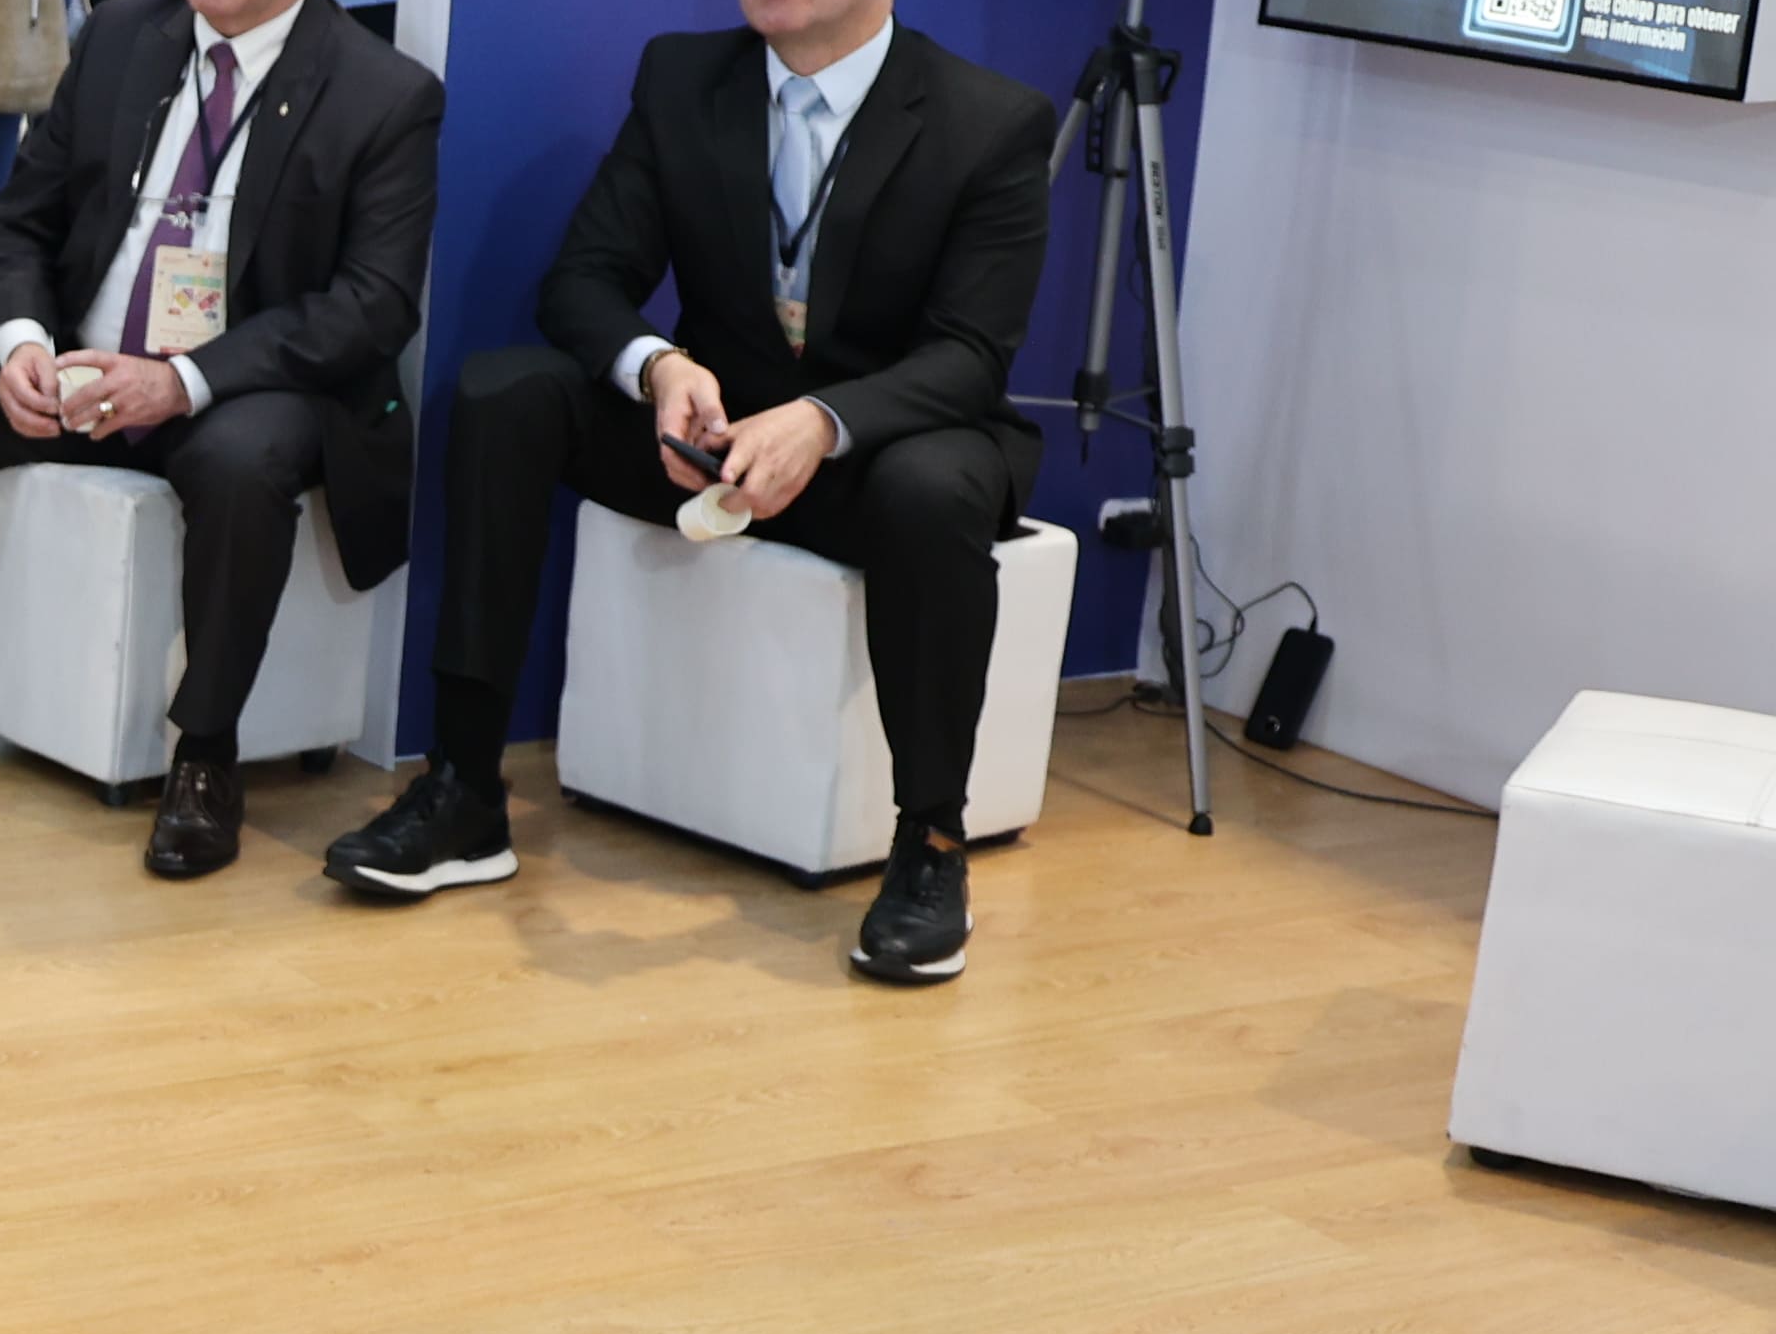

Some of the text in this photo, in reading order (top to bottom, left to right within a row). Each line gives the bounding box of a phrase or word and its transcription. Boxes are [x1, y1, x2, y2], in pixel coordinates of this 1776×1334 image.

[1580, 15, 1686, 52] más información
[1655, 2, 1686, 26] para
[1687, 6, 1741, 34] obtener
